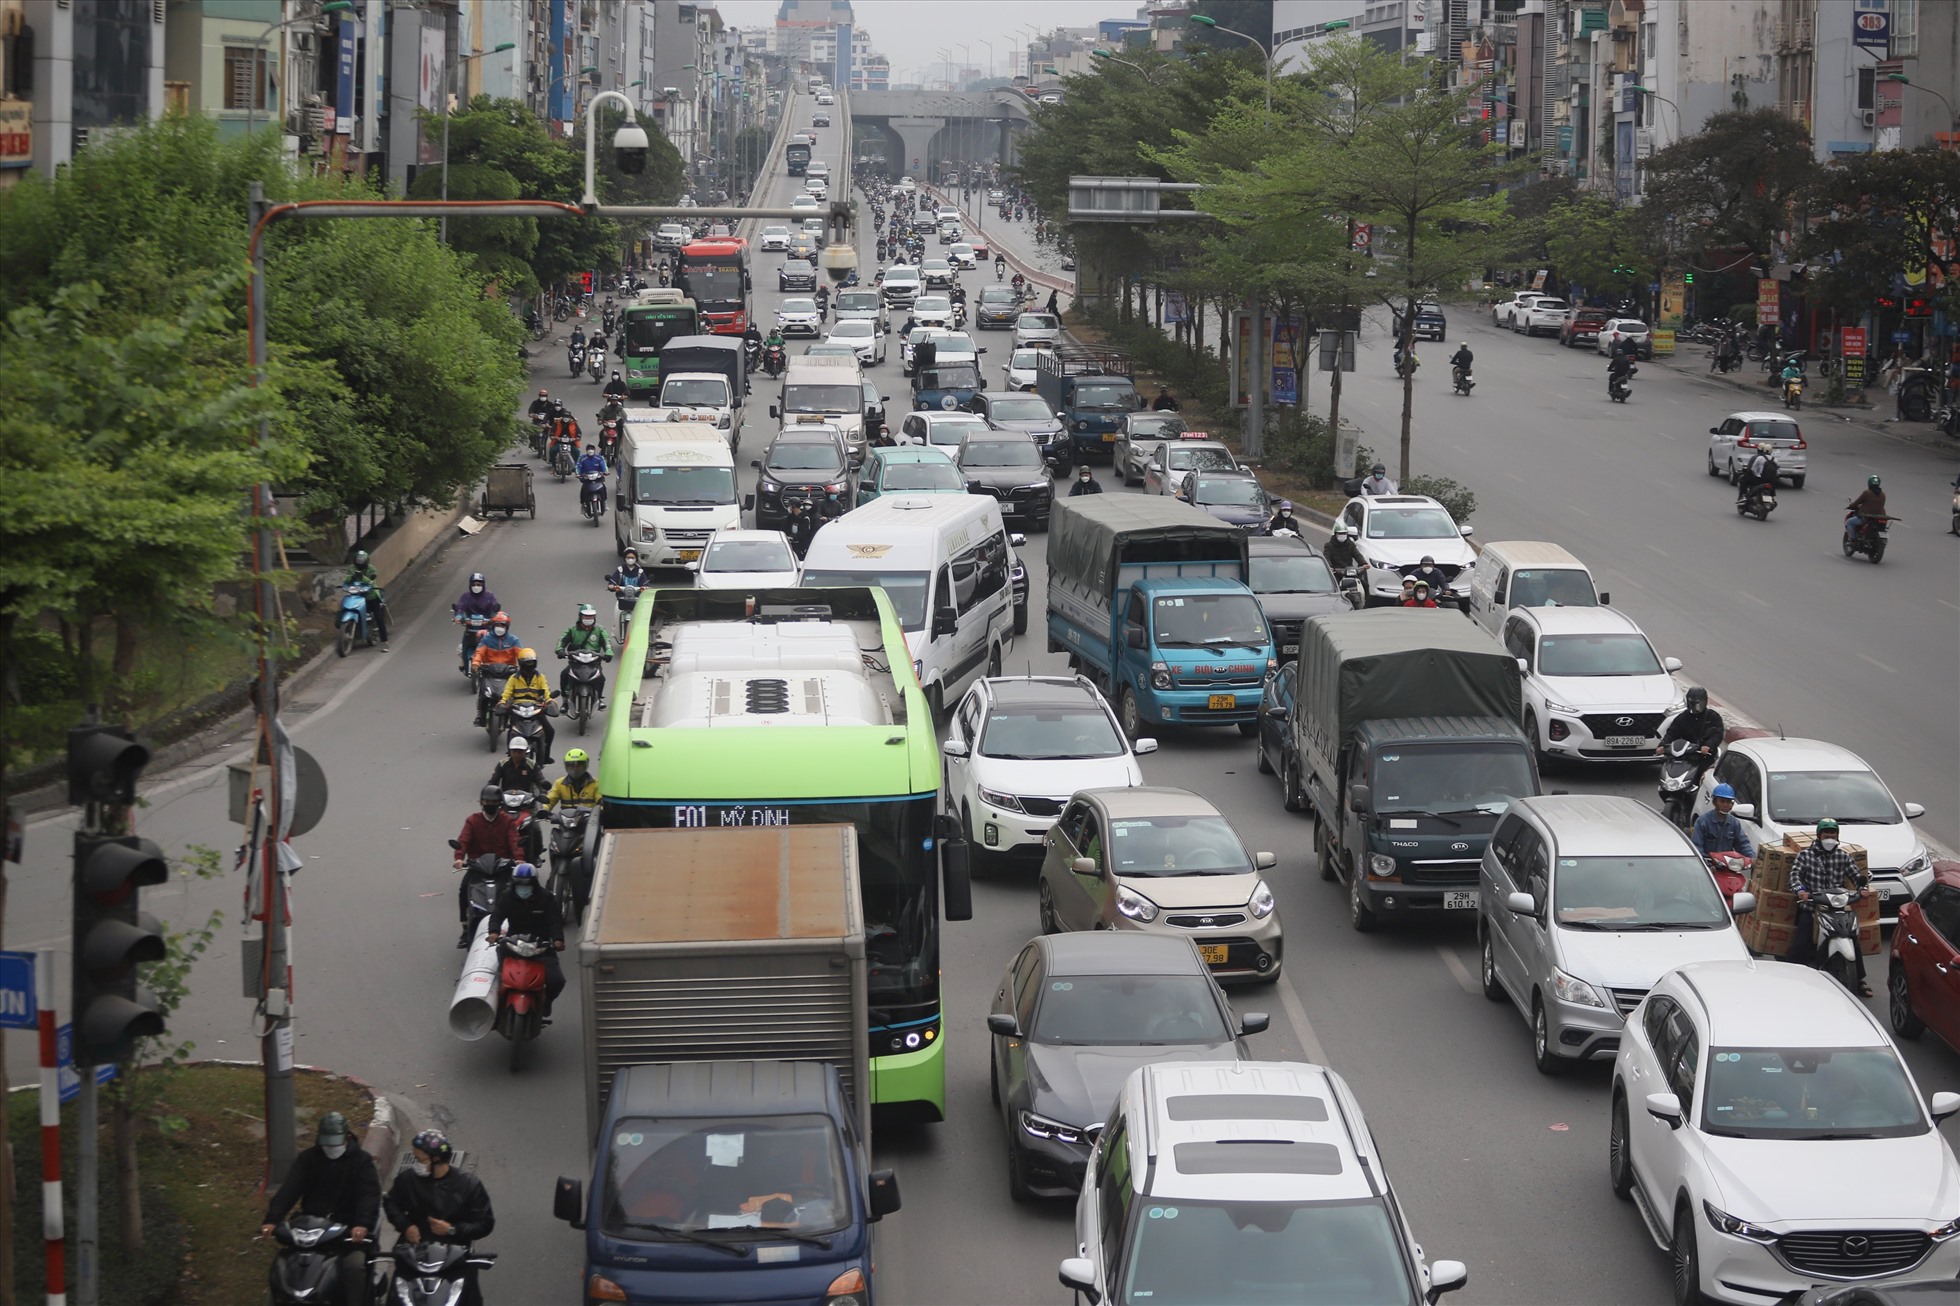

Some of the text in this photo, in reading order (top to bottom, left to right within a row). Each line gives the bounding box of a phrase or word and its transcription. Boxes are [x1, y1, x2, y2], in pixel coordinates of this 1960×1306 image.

[1862, 15, 1882, 30] 363
[1171, 665, 1183, 675] XE
[1453, 892, 1470, 900] 29H
[1447, 900, 1475, 909] 610.12
[1202, 946, 1218, 955] 30E
